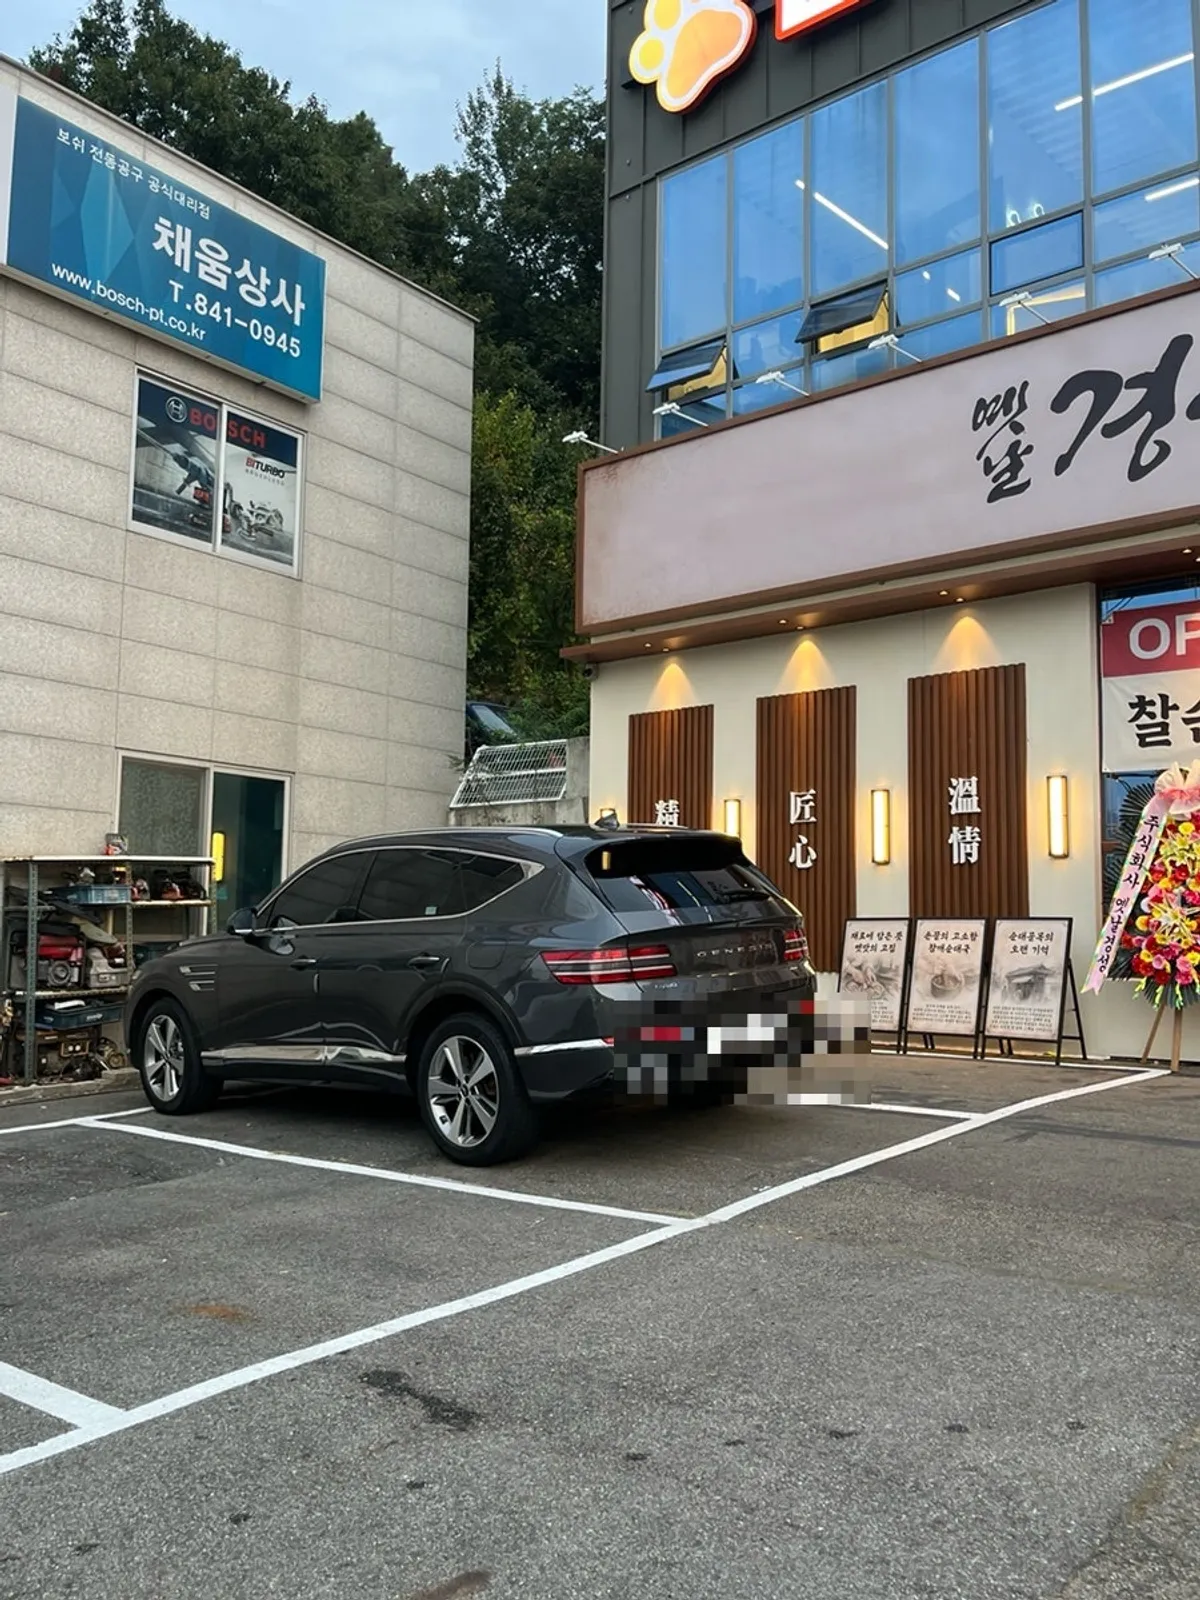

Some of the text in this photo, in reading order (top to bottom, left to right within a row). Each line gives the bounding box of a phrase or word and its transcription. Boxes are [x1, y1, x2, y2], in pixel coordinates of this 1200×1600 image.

[57, 128, 211, 220] 보쉬 전동공구 공식대리점
[51, 262, 207, 341] www.bosch-pt.co.kr
[152, 217, 306, 326] 채움상사
[189, 407, 266, 449] BOSCH
[1050, 334, 1200, 482] 경
[246, 456, 286, 479] BITURBO
[789, 789, 818, 869] 匠心
[1123, 815, 1160, 890] 주식회사
